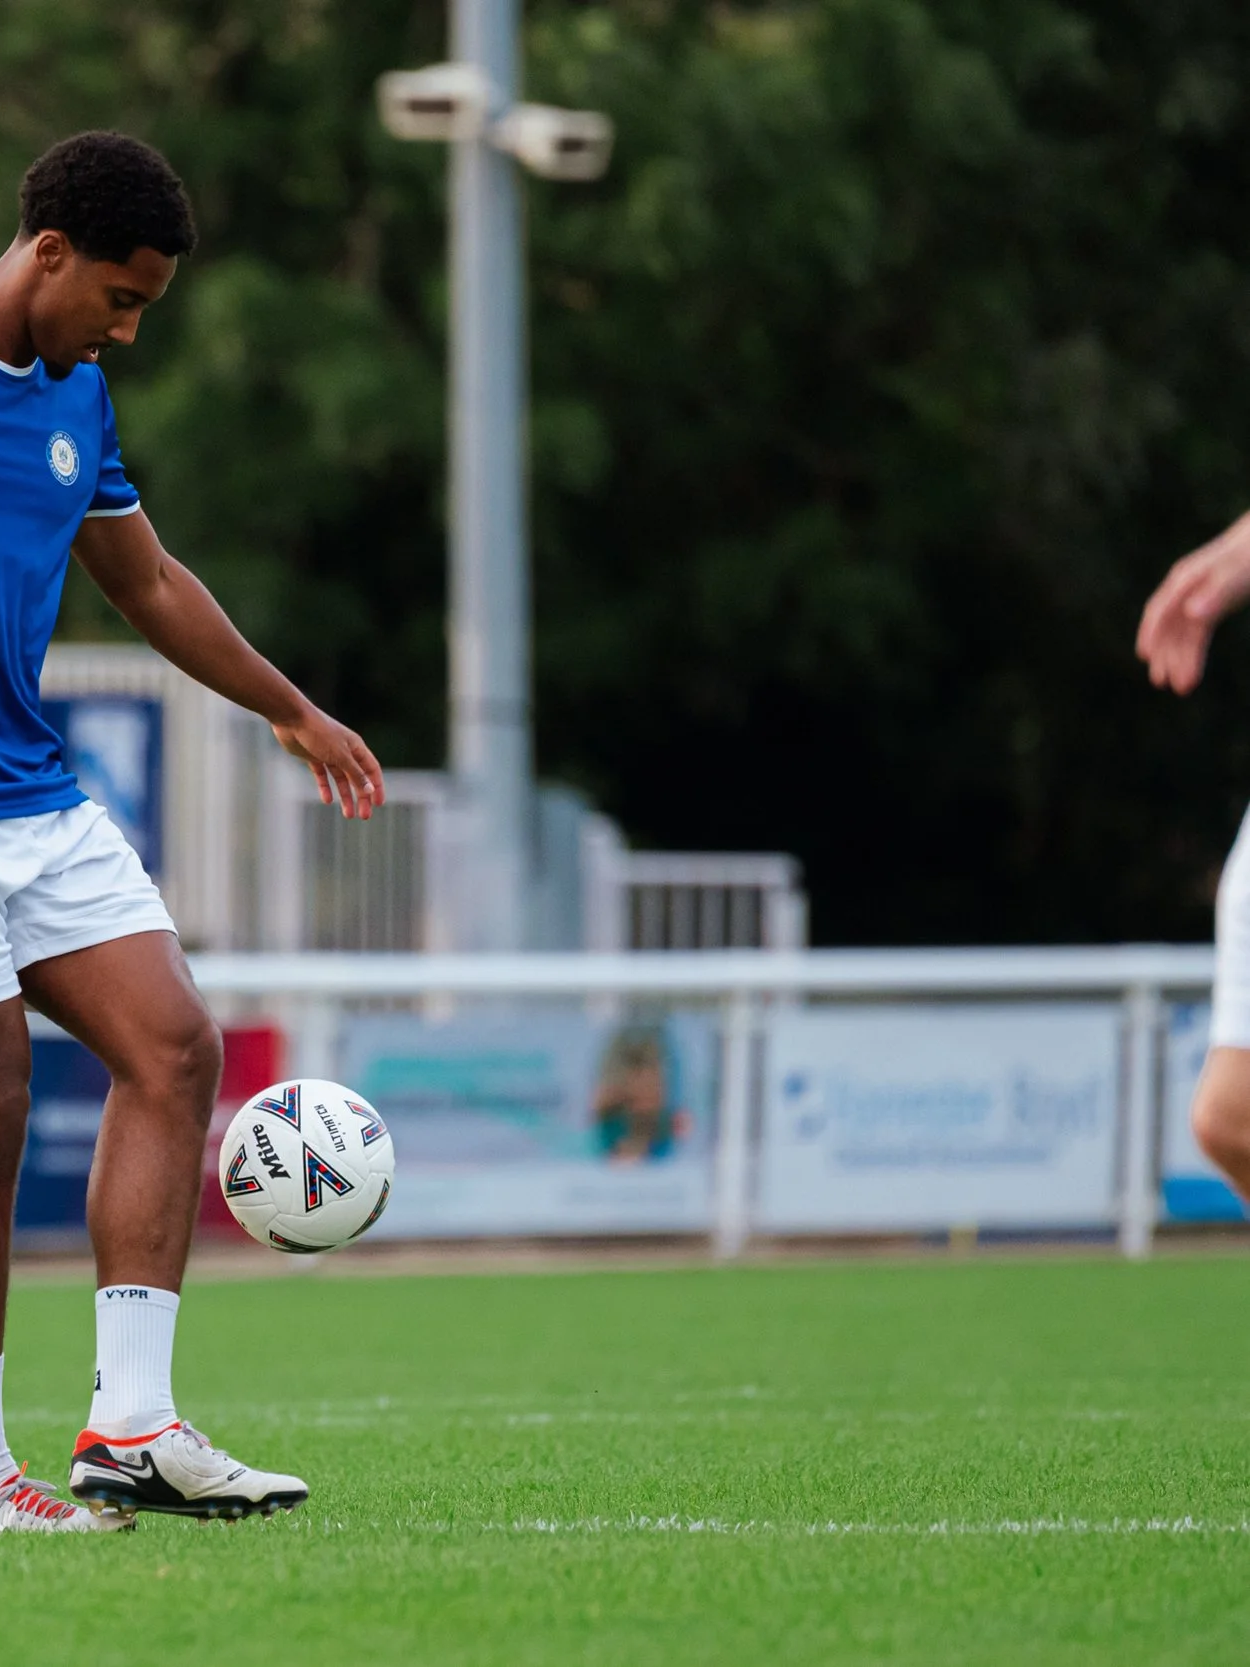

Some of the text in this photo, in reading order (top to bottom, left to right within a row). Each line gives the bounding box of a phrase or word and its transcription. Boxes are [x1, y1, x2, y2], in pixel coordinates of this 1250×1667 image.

[253, 1124, 291, 1179] Mitre
[314, 1104, 347, 1152] ULTIMATCH
[105, 1289, 148, 1299] VYPR
